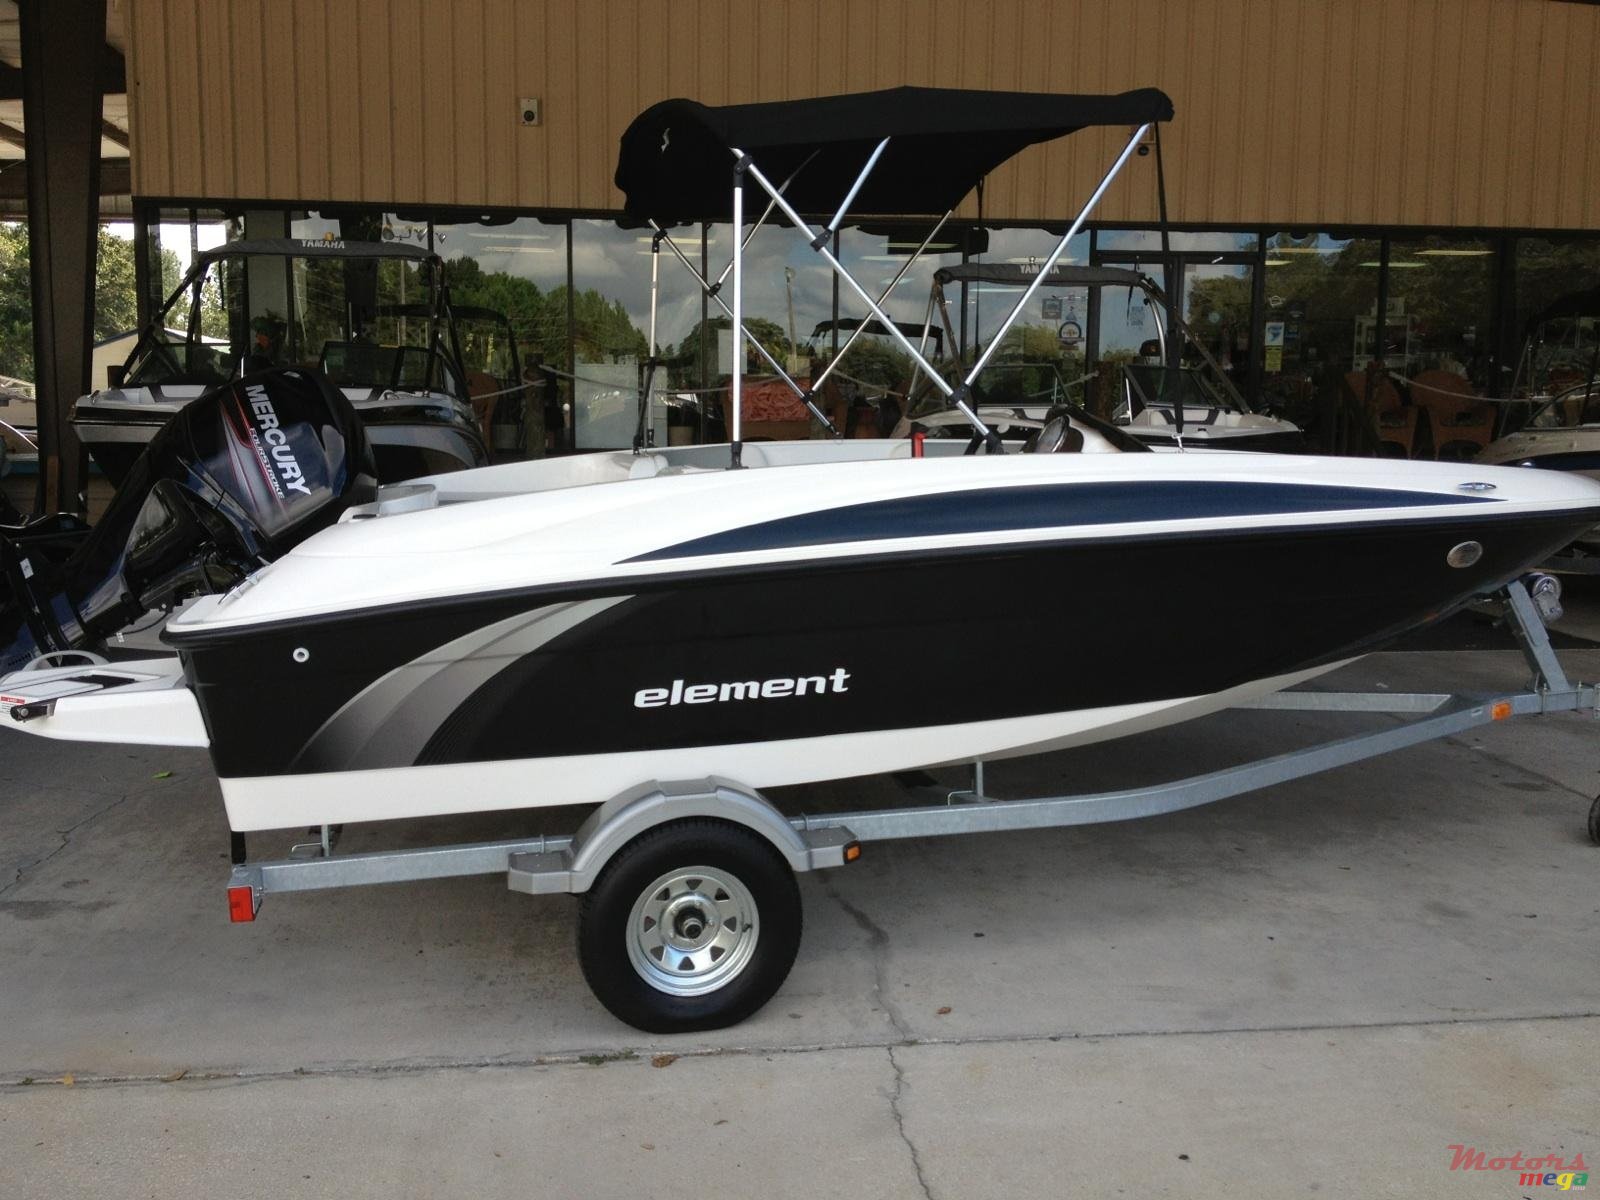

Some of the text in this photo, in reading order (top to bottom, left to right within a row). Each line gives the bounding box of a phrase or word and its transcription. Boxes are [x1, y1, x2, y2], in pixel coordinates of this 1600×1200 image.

[301, 240, 345, 249] YAMAHA
[1020, 264, 1060, 274] YAMA
[245, 384, 312, 496] MERCURY
[633, 668, 851, 708] element
